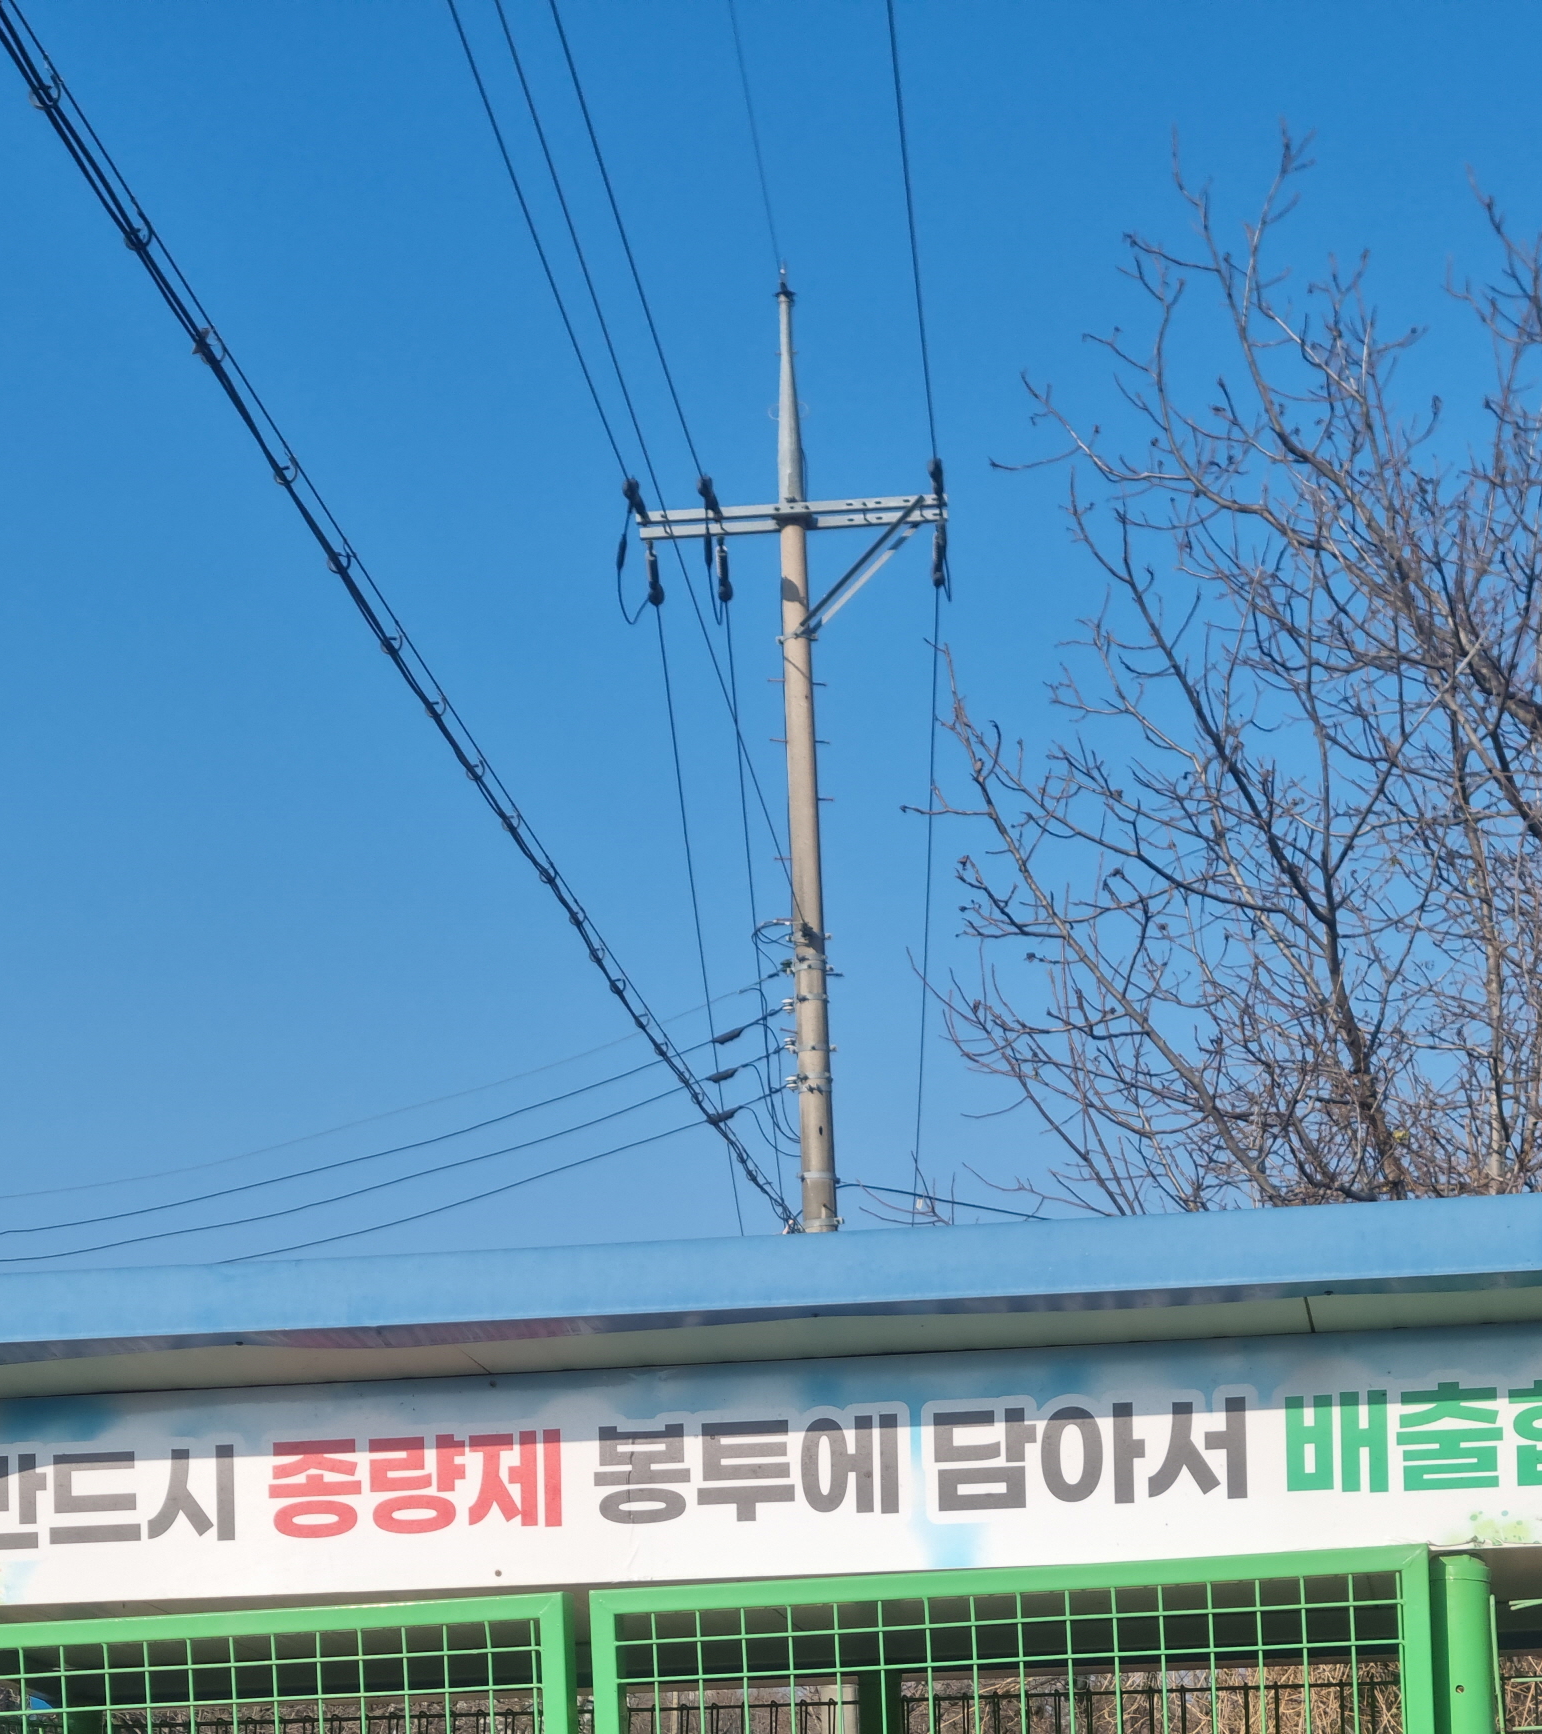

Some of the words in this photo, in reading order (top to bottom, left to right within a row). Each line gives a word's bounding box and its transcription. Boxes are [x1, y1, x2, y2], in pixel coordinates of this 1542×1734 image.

[268, 1428, 563, 1541] 종량제
[593, 1413, 900, 1525] 봉투에
[932, 1396, 1249, 1512] 담아서
